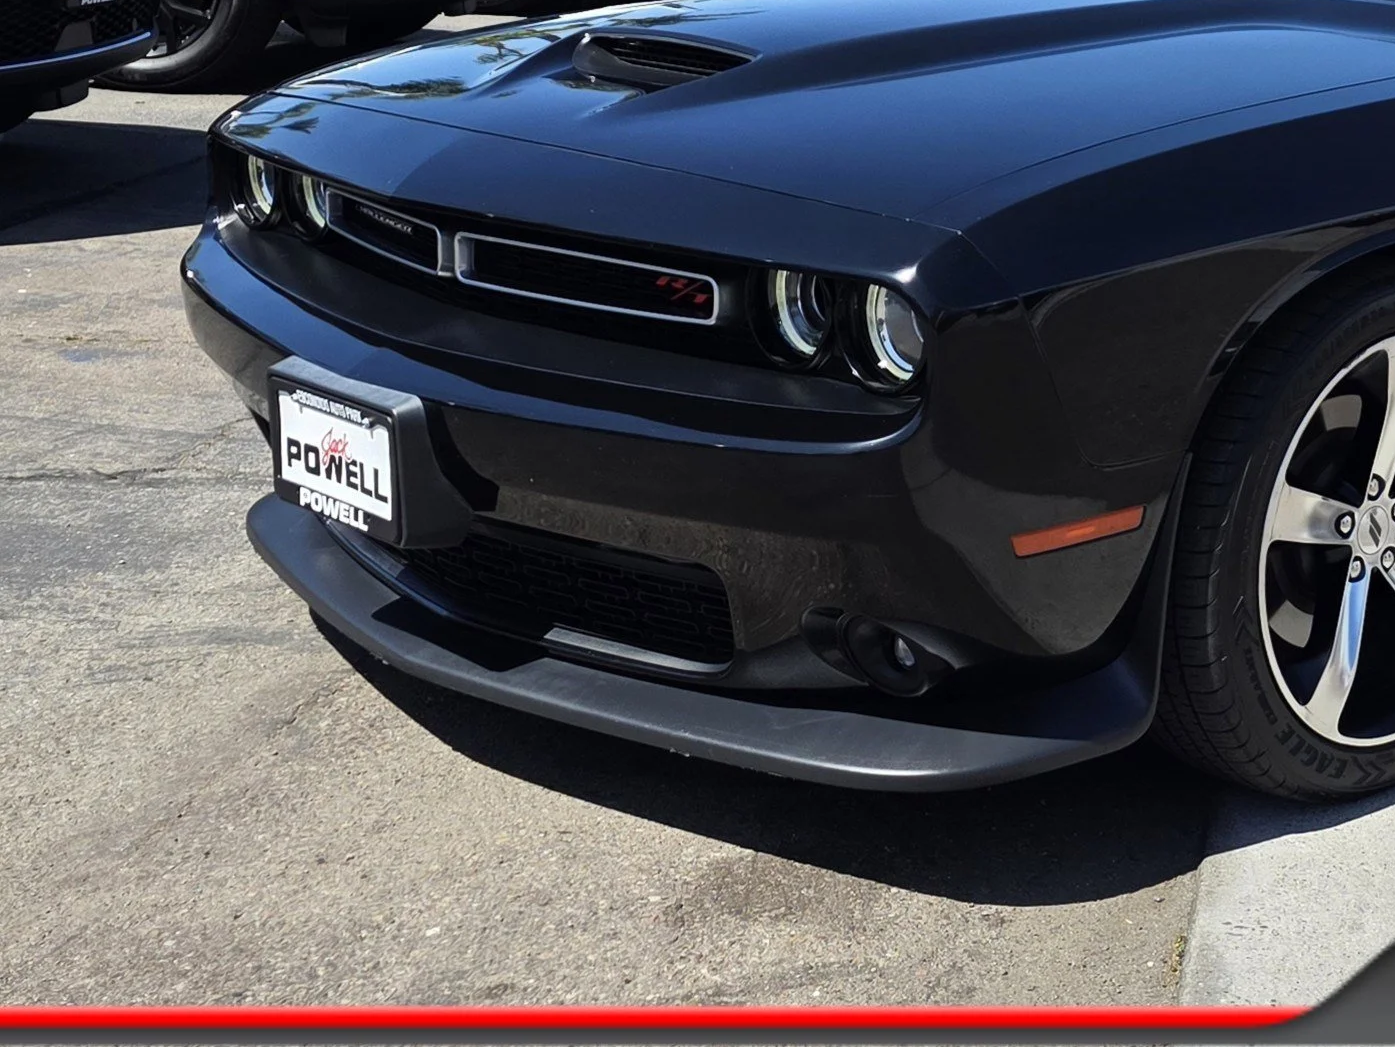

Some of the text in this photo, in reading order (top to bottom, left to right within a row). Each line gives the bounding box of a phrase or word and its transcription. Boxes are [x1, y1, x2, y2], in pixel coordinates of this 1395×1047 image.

[287, 437, 389, 504] POWELL
[321, 427, 353, 467] Jack
[299, 486, 369, 532] POWELL
[1274, 720, 1348, 780] EAGLE
